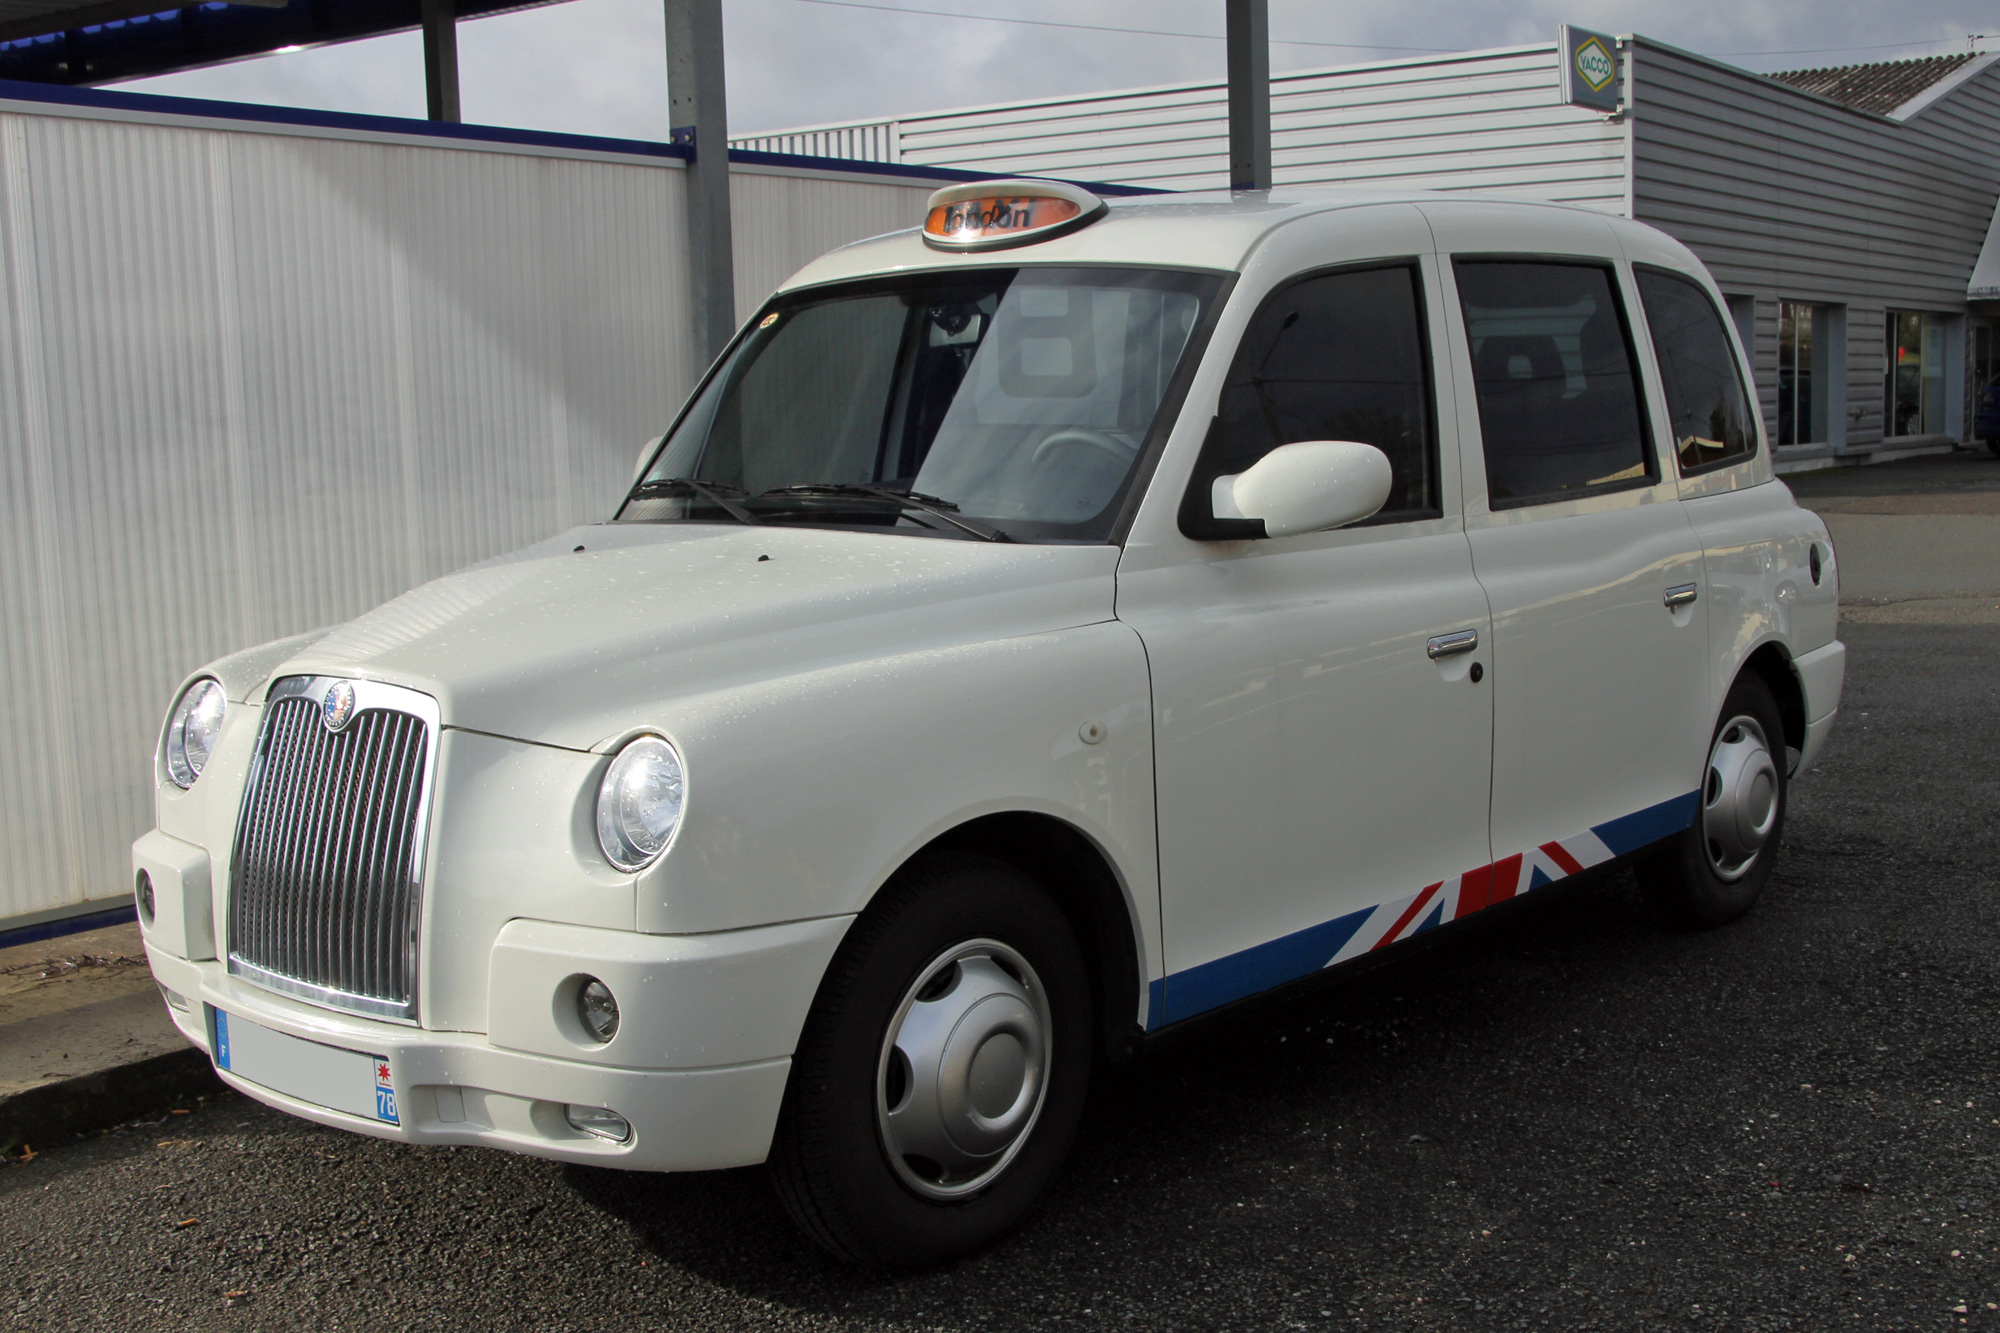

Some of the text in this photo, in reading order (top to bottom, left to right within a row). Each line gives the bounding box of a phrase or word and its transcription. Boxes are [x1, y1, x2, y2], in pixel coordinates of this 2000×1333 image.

[1580, 55, 1609, 75] YACCO
[943, 205, 1030, 233] london
[221, 1044, 226, 1057] F
[377, 1090, 396, 1116] 78
